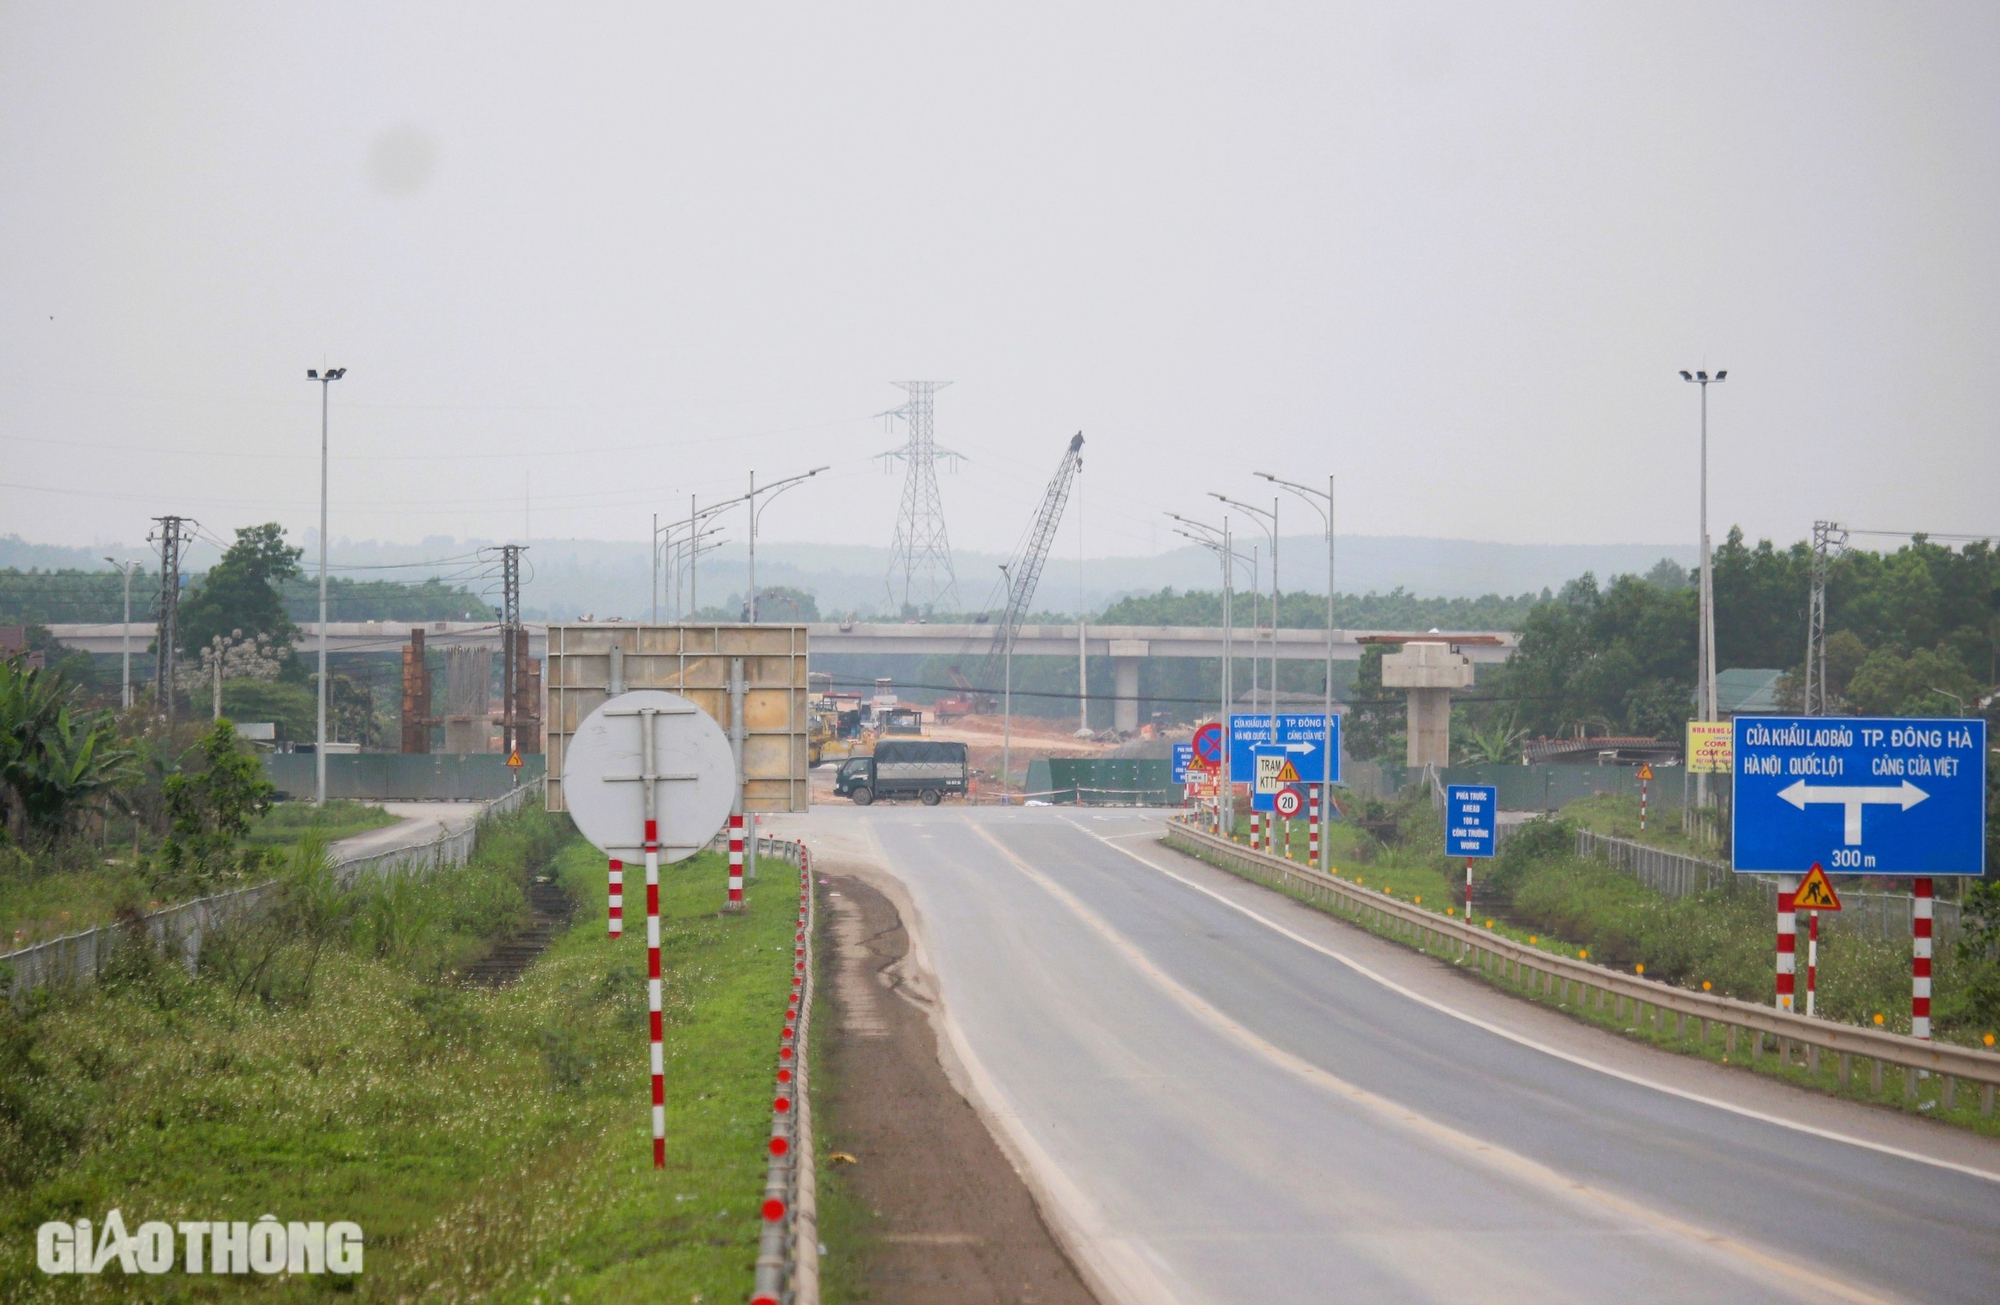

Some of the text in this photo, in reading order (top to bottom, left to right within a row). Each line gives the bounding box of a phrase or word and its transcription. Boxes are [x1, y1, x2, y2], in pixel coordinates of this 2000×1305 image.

[1298, 717, 1321, 727] ĐÔNG
[1746, 723, 1771, 746] CỬA
[1772, 722, 1804, 746] KHẨU
[1861, 726, 1973, 748] TP. ĐÔNG HÀ
[1261, 759, 1281, 775] TRẠM
[1744, 753, 1760, 775] HÀ
[1761, 754, 1781, 777] NỘI
[1789, 752, 1820, 775] QUỐC
[1872, 753, 1959, 778] CẢNG CỬA VIỆT
[1282, 797, 1293, 808] 20
[1462, 804, 1480, 813] AHEAD
[1460, 841, 1480, 850] WORKS
[1831, 849, 1876, 868] 300 m
